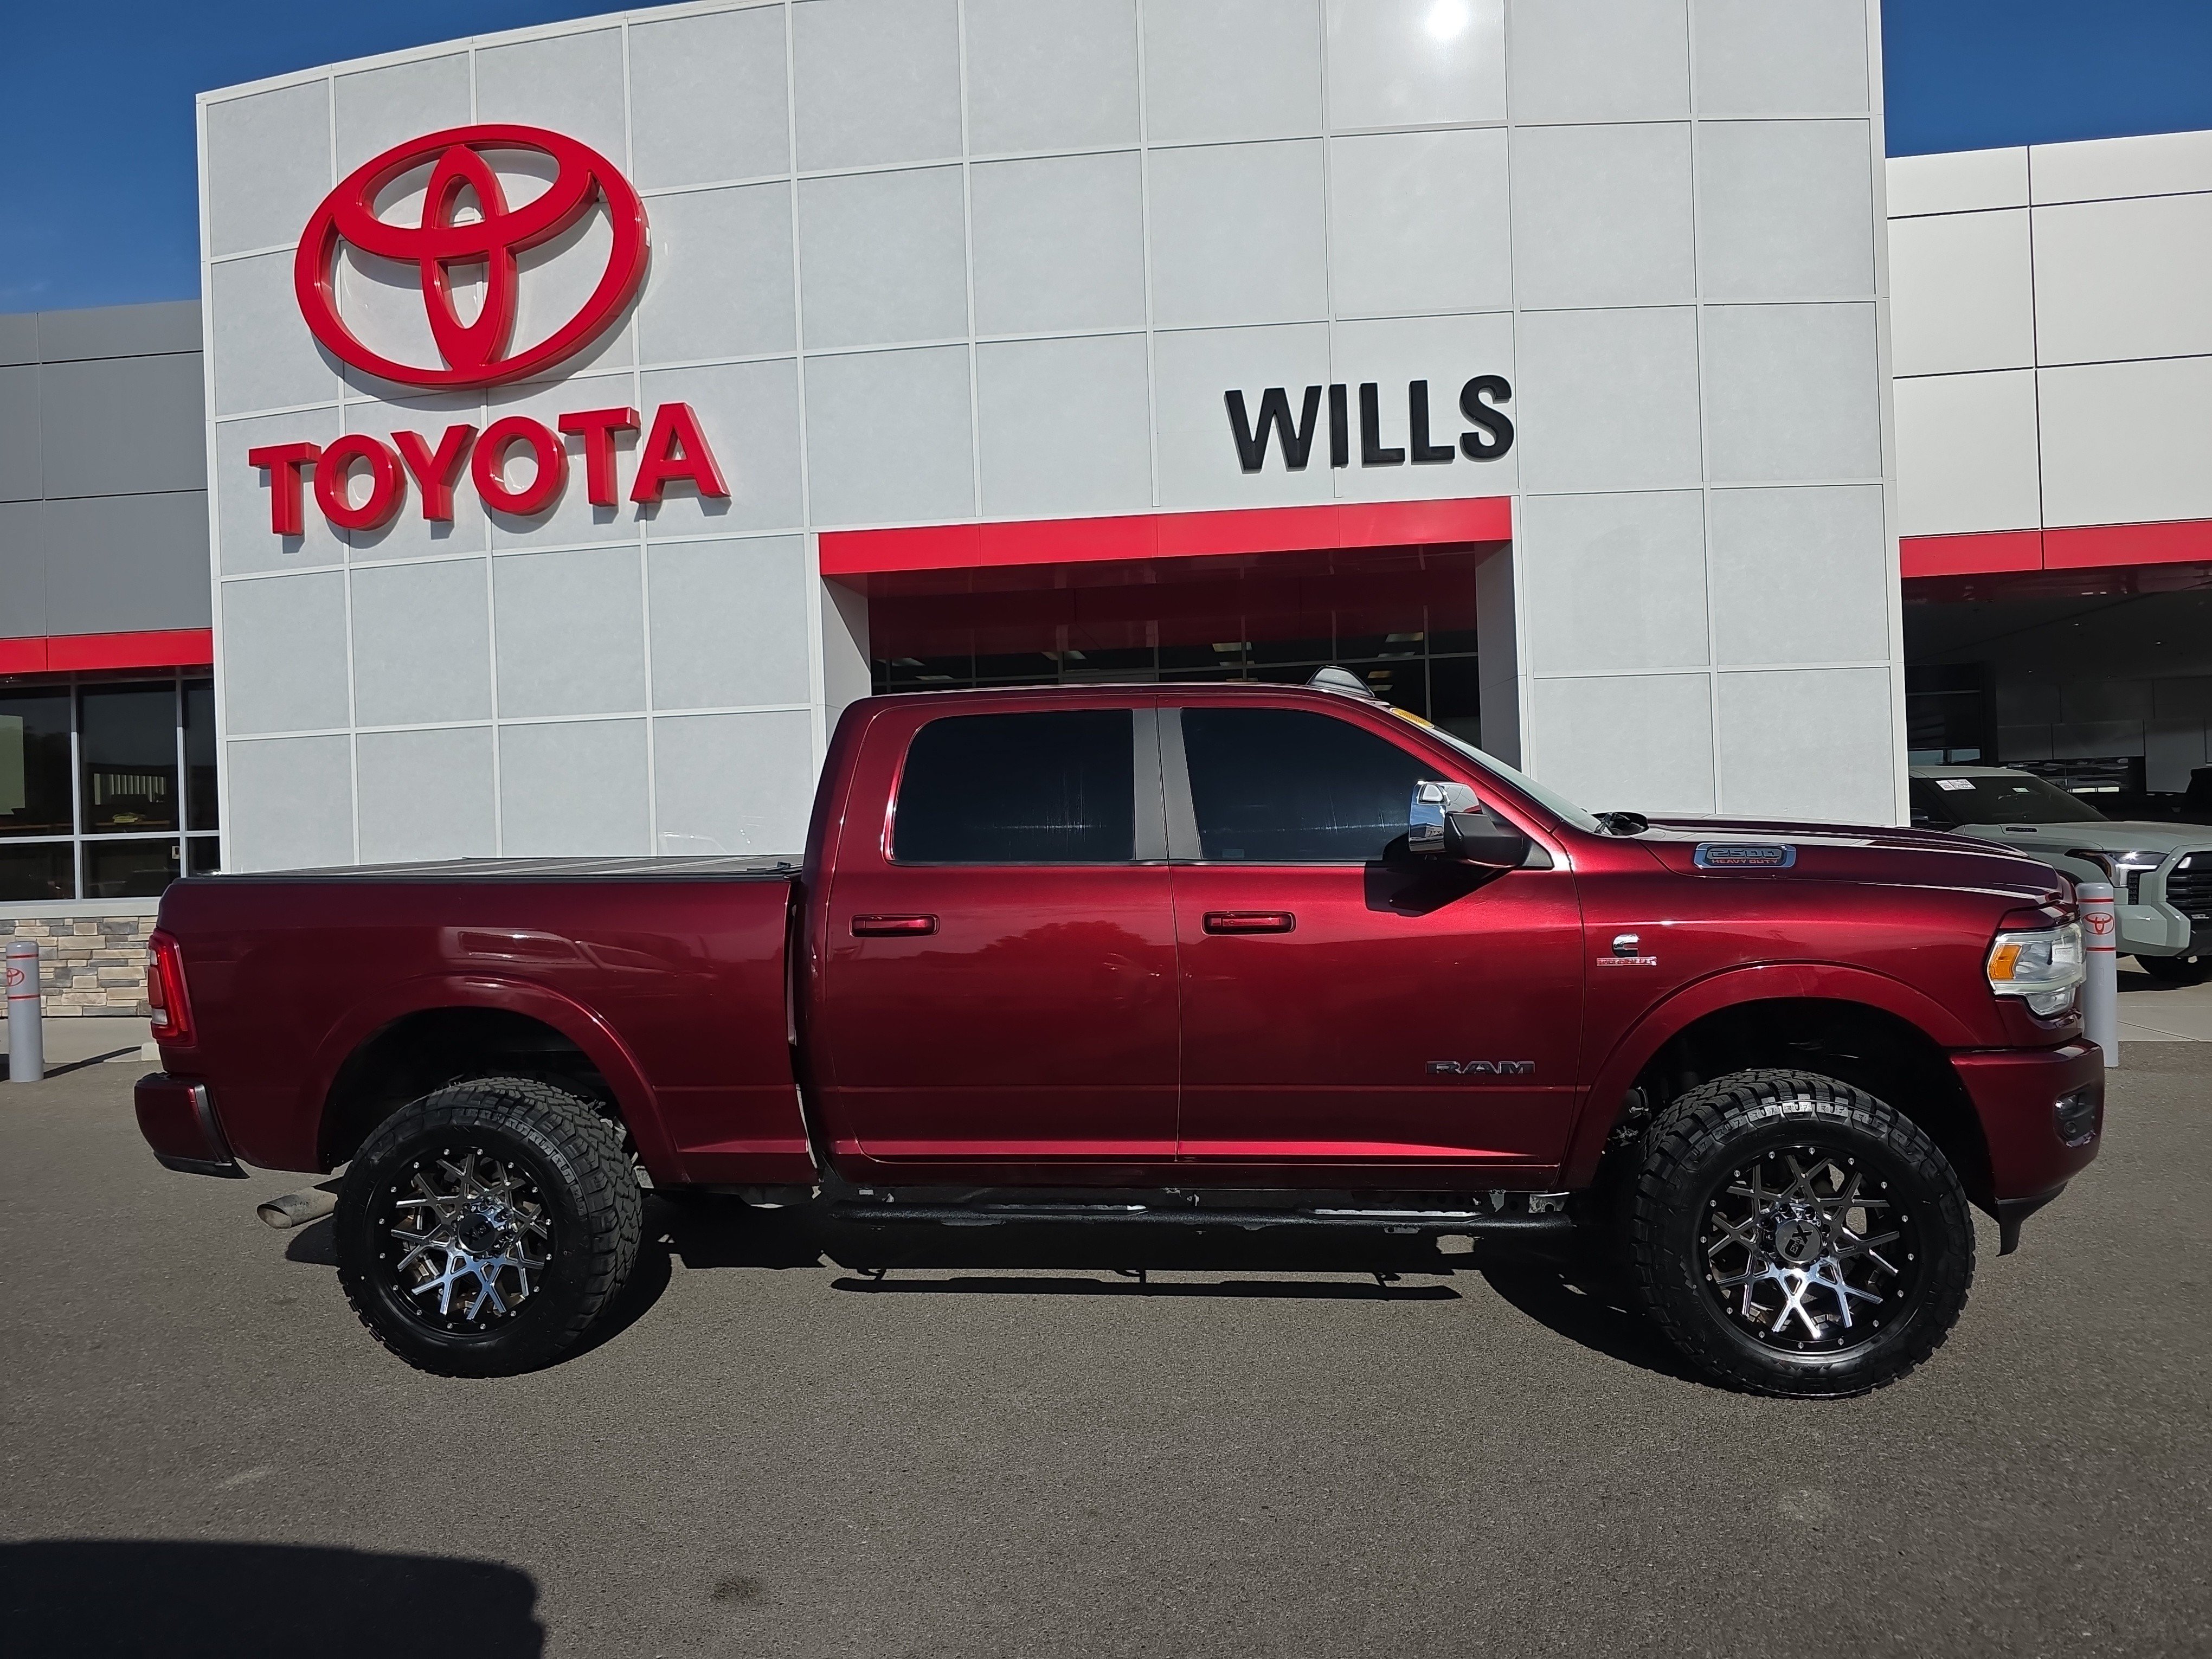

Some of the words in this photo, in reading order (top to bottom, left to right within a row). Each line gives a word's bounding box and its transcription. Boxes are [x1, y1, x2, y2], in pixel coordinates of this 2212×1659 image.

[1224, 375, 1514, 473] WILLS
[249, 402, 731, 536] TOYOTA
[1710, 849, 1779, 858] 2500
[1426, 1061, 1535, 1074] RAM
